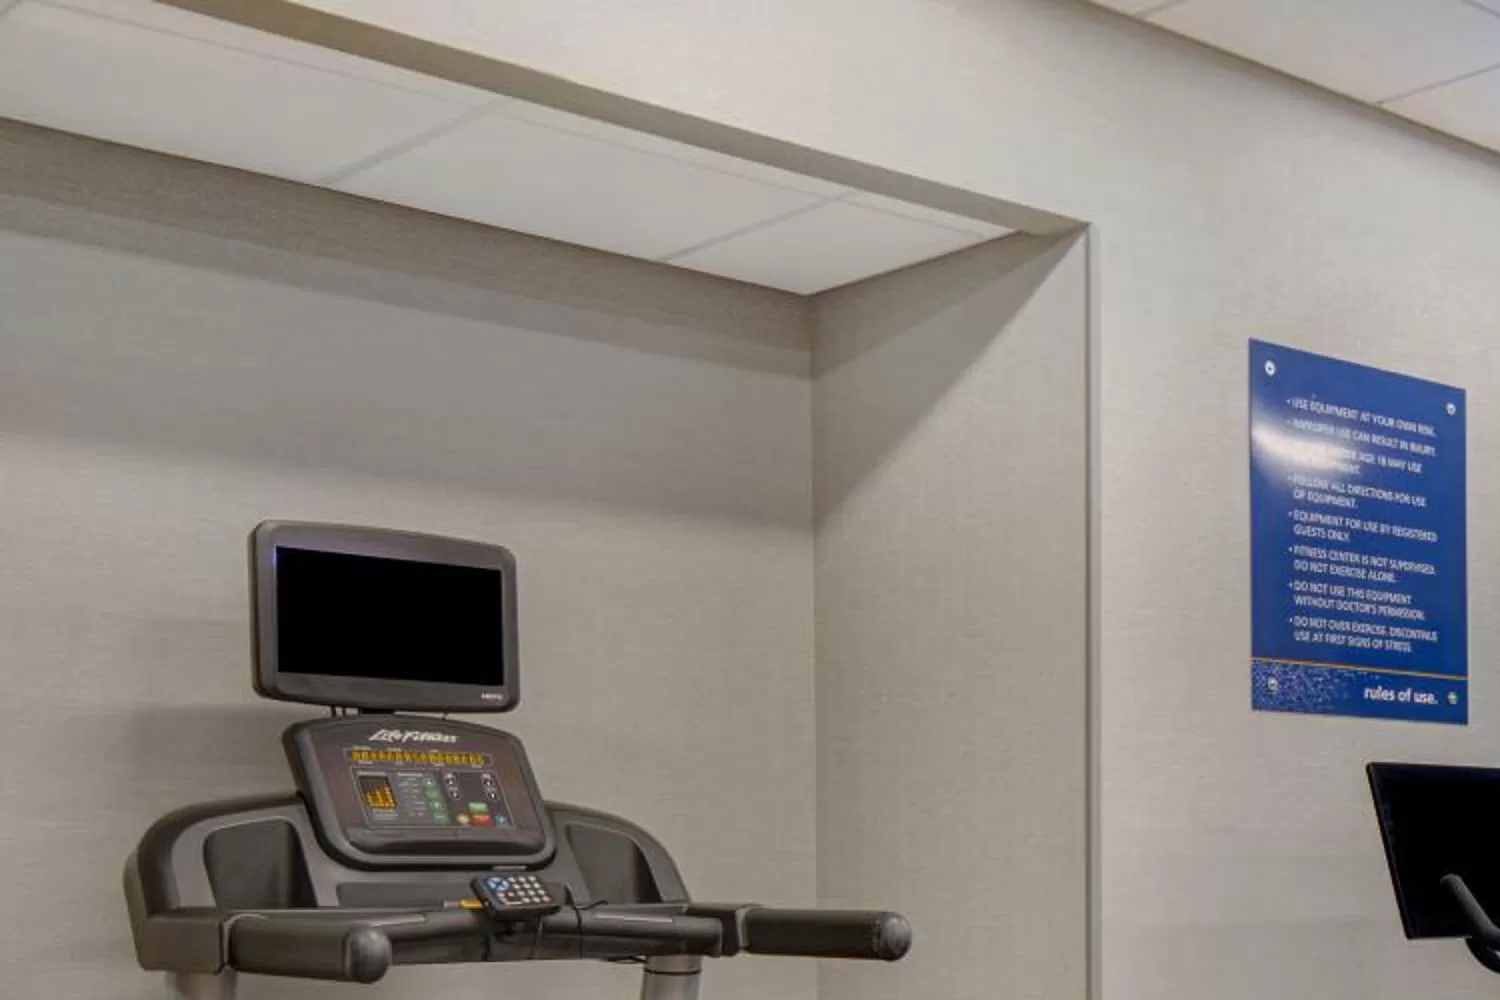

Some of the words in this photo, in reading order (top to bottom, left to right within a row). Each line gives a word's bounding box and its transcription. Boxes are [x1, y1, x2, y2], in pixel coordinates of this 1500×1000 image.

[1372, 413, 1395, 428] YOUR
[1352, 430, 1370, 443] CAN
[1293, 487, 1305, 499] OF
[1293, 509, 1344, 527] EQUIPMENT
[1345, 517, 1361, 529] FOR
[1363, 520, 1379, 533] USE
[1328, 549, 1361, 564] CENTER
[1370, 556, 1388, 567] NOT
[1293, 559, 1308, 571] DO
[1309, 561, 1328, 573] NOT
[1293, 580, 1309, 591] DO
[1310, 582, 1328, 594] NOT
[1329, 584, 1345, 596] USE
[1347, 586, 1365, 598] THIS
[1365, 589, 1412, 604] EQUIPMENT
[1294, 595, 1336, 608] WITHOUT
[1293, 615, 1308, 627] DO
[1309, 618, 1327, 629] NOT
[1294, 631, 1310, 642] USE
[1364, 686, 1395, 701] rules
[1399, 687, 1411, 701] of
[1413, 692, 1439, 705] use.
